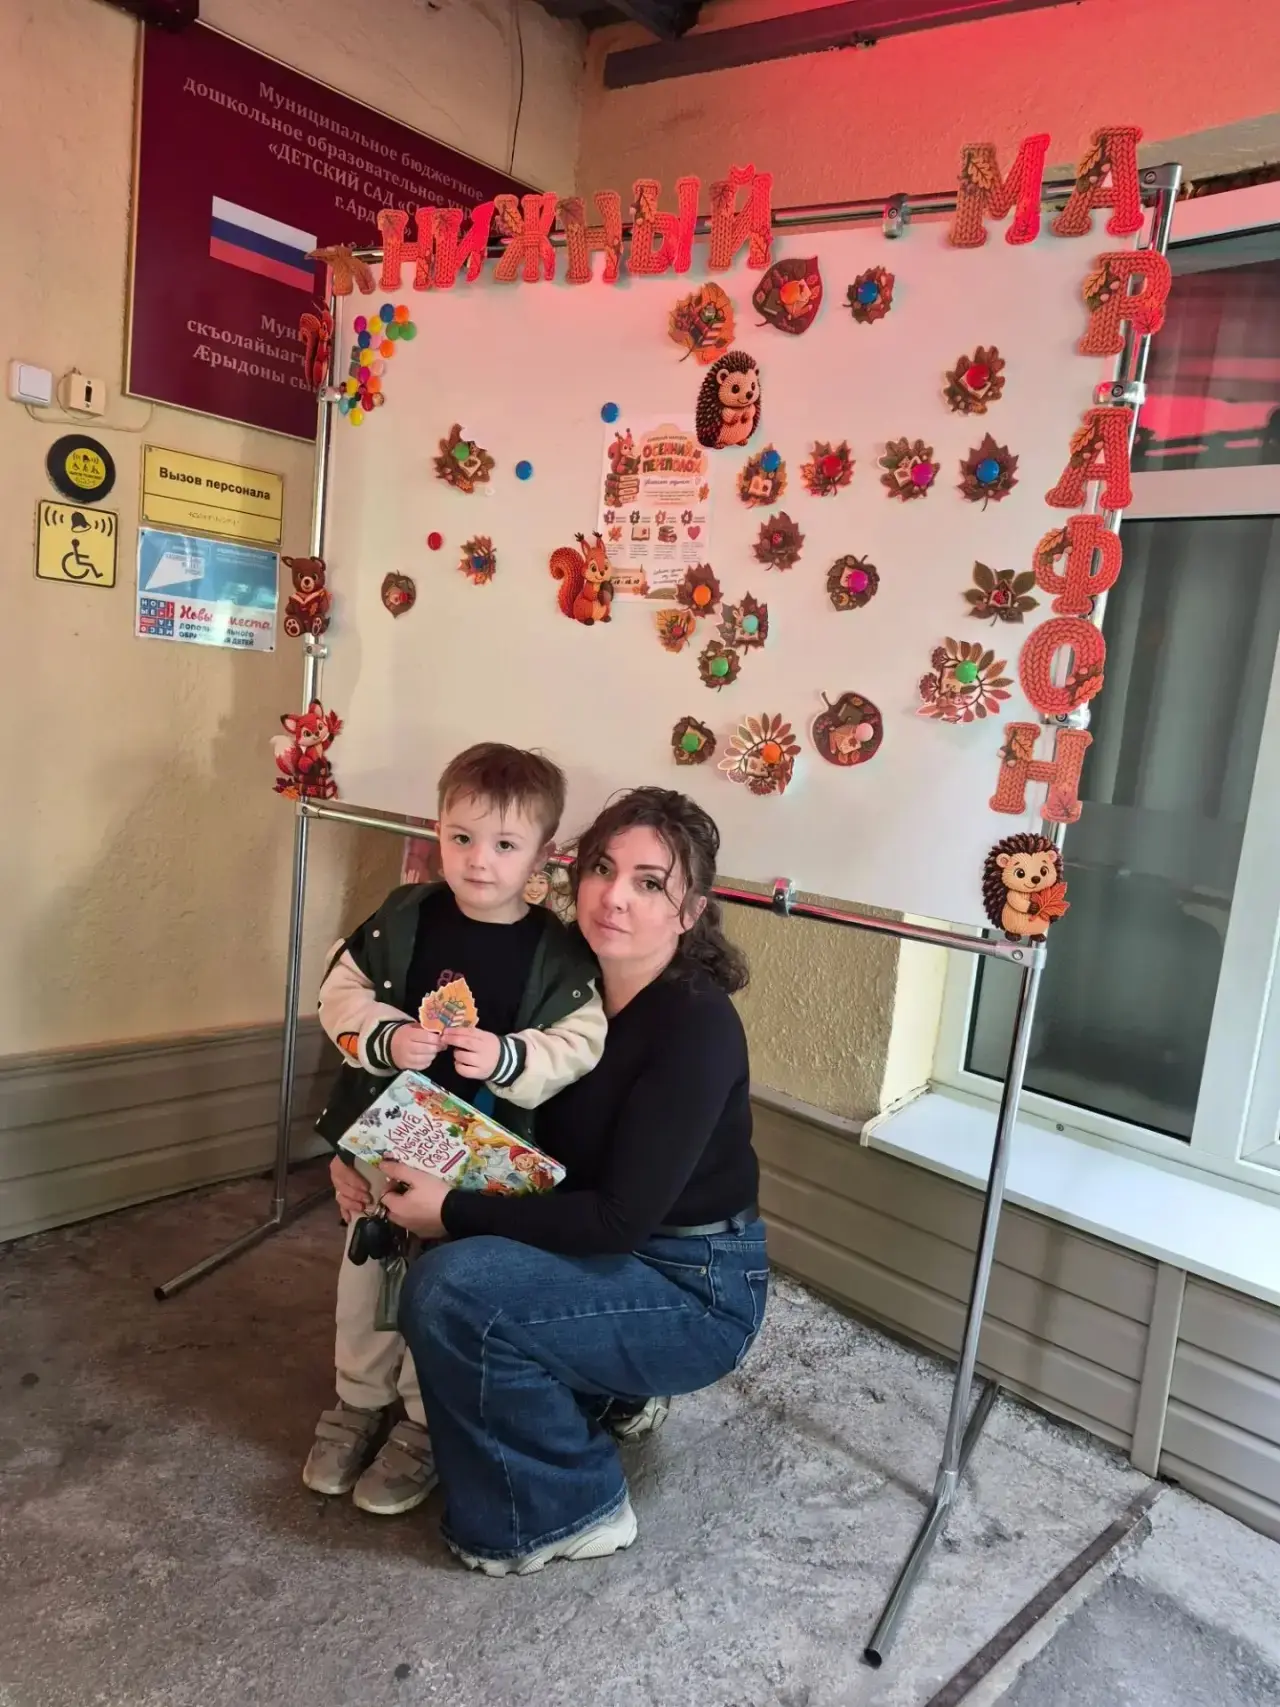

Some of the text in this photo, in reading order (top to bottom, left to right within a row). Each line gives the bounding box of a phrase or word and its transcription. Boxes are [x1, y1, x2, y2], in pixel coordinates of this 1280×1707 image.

[183, 76, 445, 206] дошкольное образовательное
[259, 81, 484, 201] Муниципальное бюджетное
[268, 142, 359, 192] «ДЕТСКИЙ
[363, 181, 395, 209] САД
[159, 466, 271, 500] Вызов персонала
[180, 605, 214, 622] Новы
